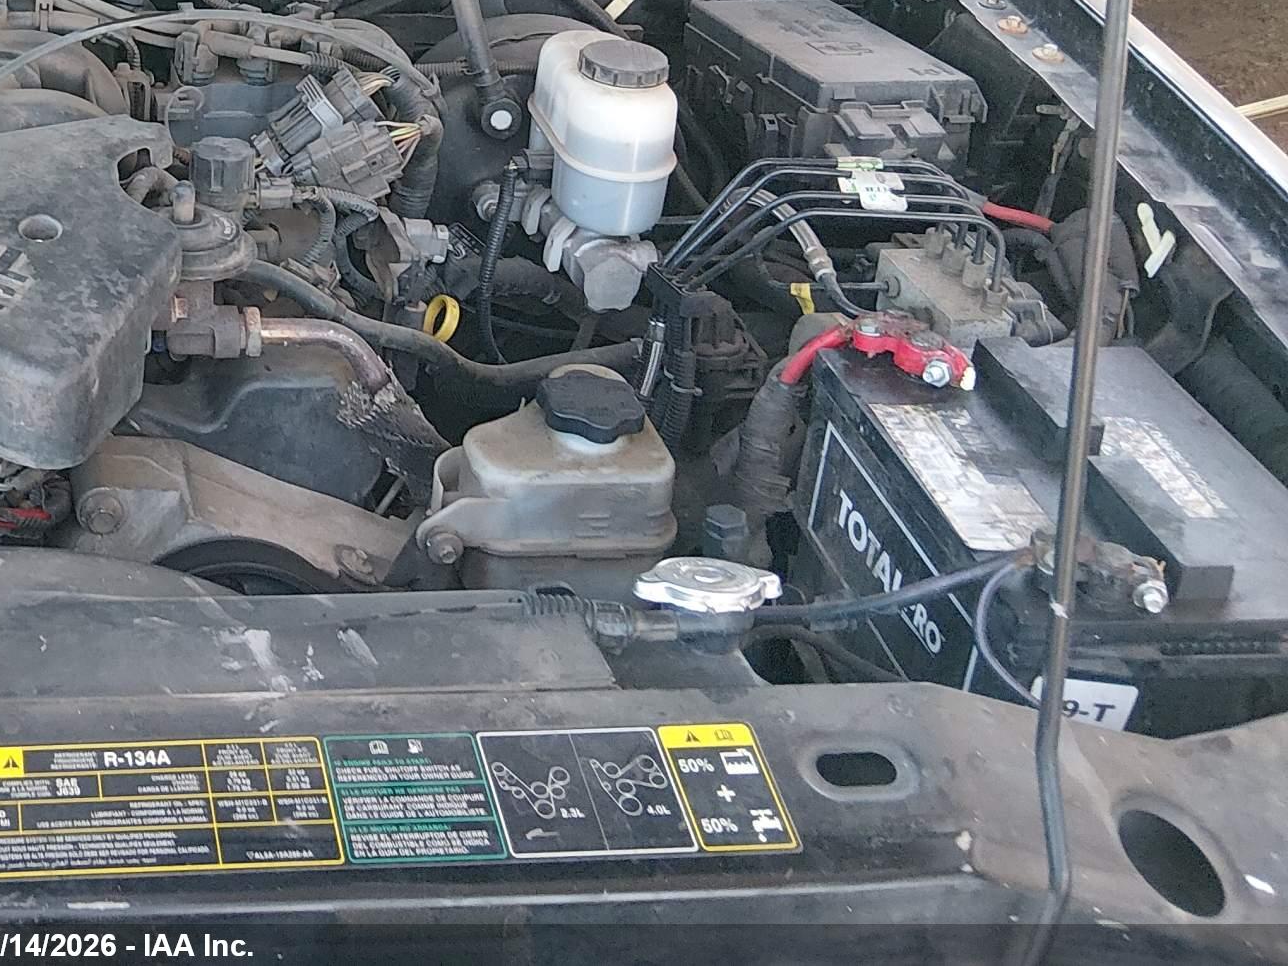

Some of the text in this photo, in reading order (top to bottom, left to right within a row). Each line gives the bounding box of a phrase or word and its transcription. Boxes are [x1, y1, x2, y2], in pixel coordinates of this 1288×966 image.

[103, 751, 171, 766] R-134A
[677, 758, 715, 773] 50%
[55, 777, 78, 787] SAE
[0, 818, 10, 827] MI
[700, 818, 739, 834] 50%
